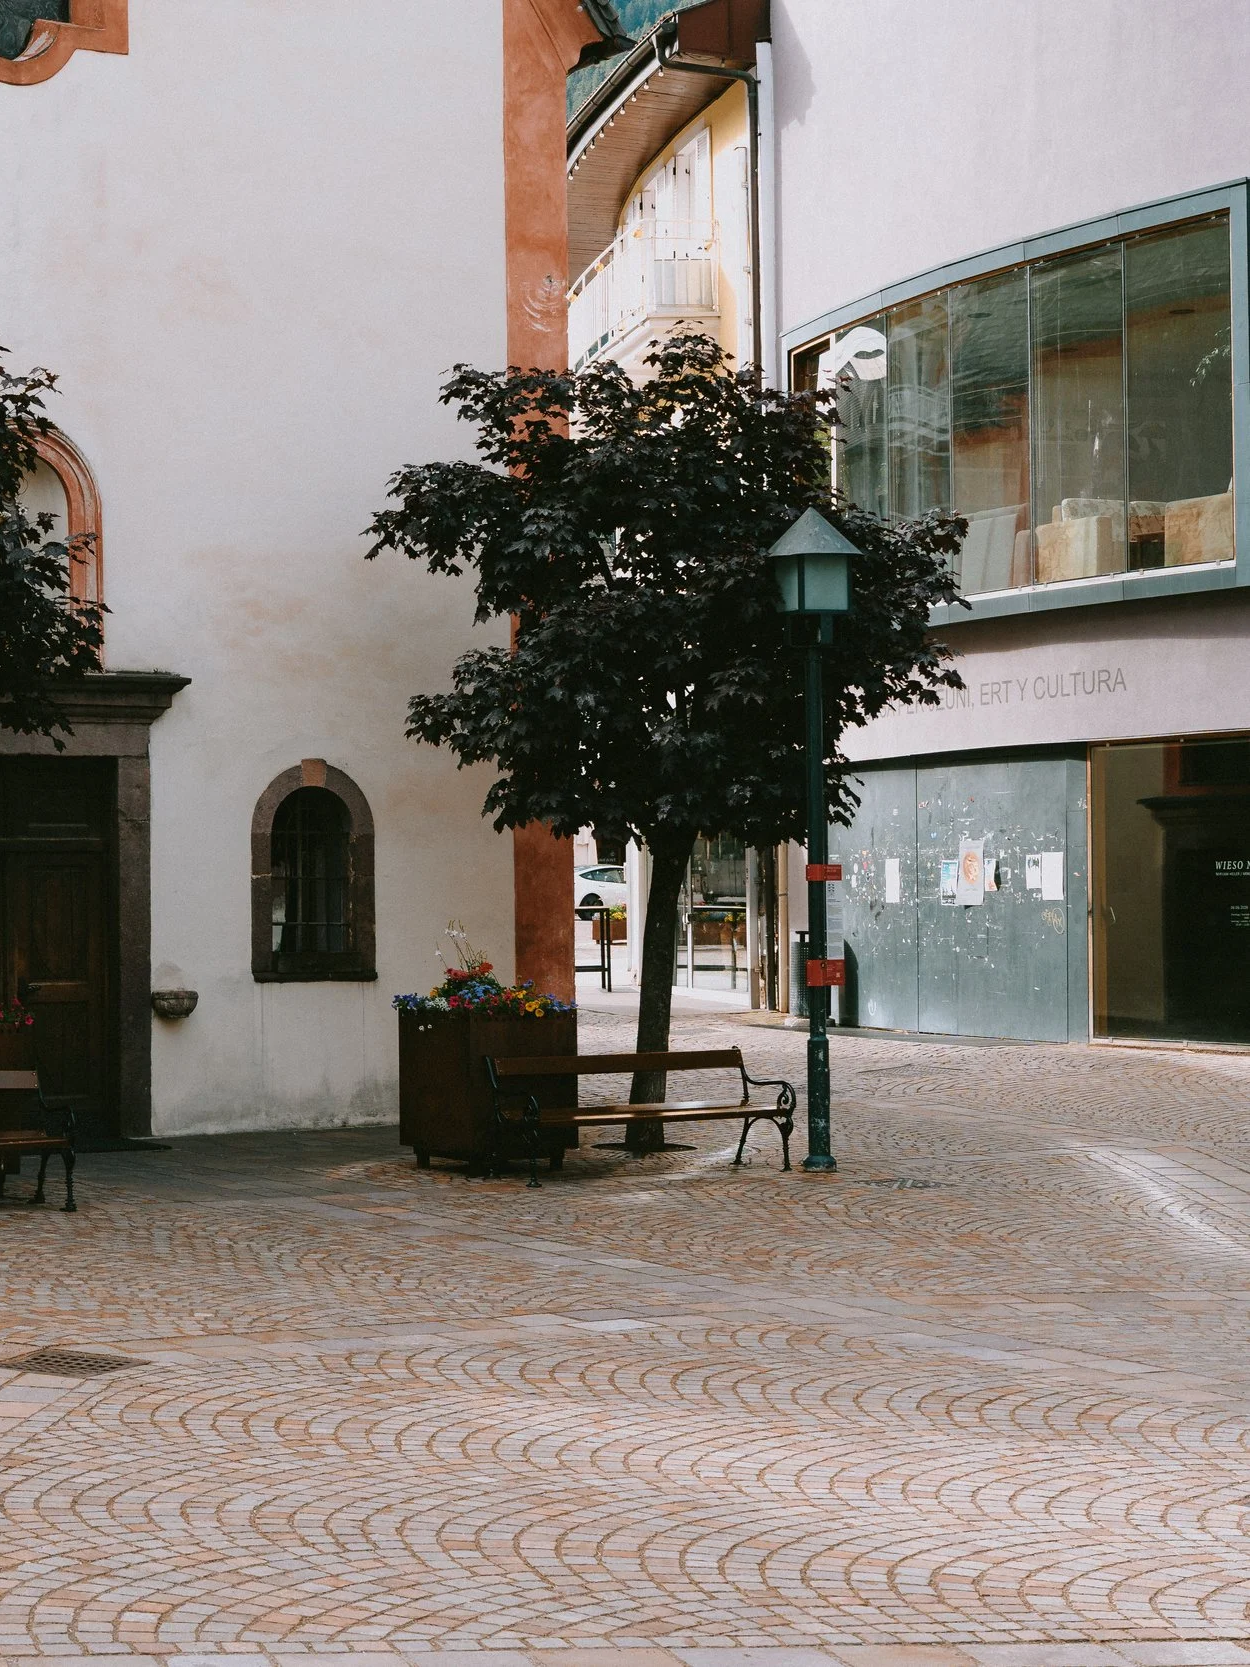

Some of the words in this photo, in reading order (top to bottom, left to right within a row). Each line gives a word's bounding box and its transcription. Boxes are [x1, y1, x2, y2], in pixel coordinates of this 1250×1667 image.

[980, 679, 1013, 706] ERT
[1017, 677, 1029, 701] Y
[1033, 667, 1127, 700] CULTURA
[1215, 861, 1243, 870] WIESO
